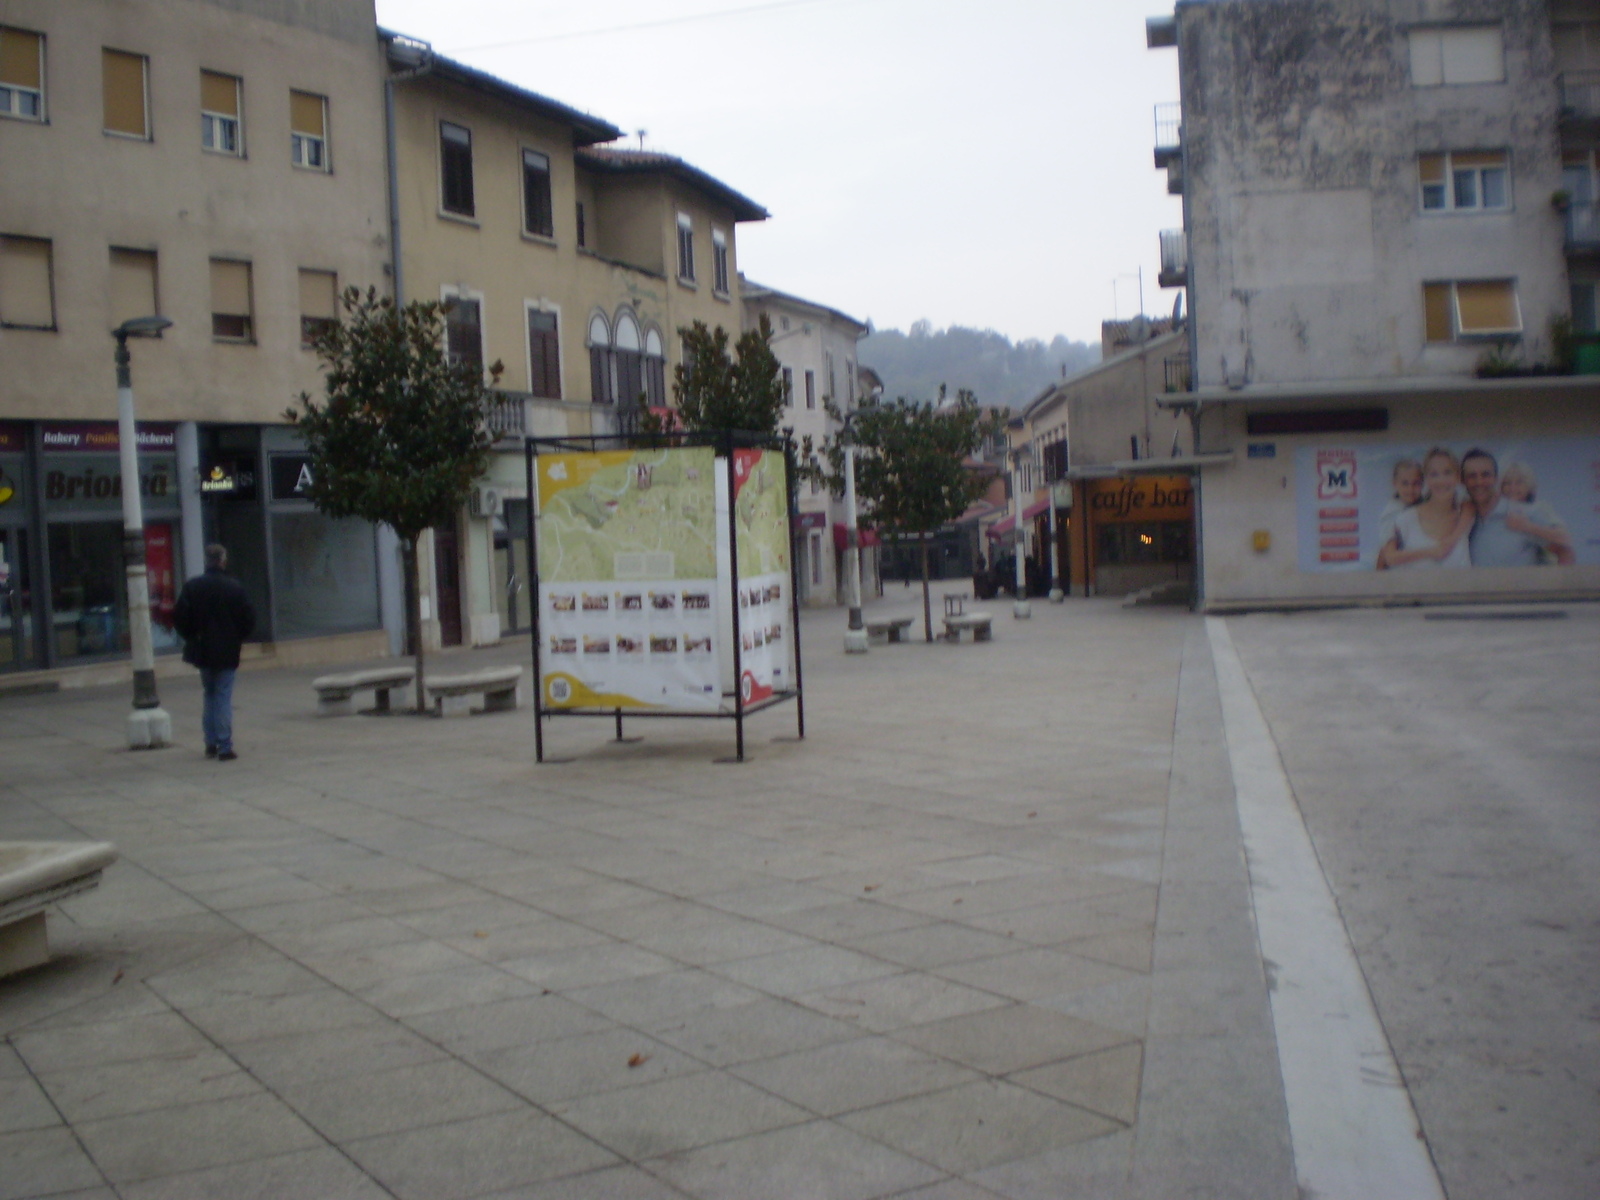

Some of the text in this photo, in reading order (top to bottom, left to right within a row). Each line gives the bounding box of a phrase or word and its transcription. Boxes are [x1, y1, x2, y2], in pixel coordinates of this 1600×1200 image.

[44, 431, 80, 446] Bakery
[1328, 470, 1347, 487] M
[1092, 480, 1194, 516] caffe bar
